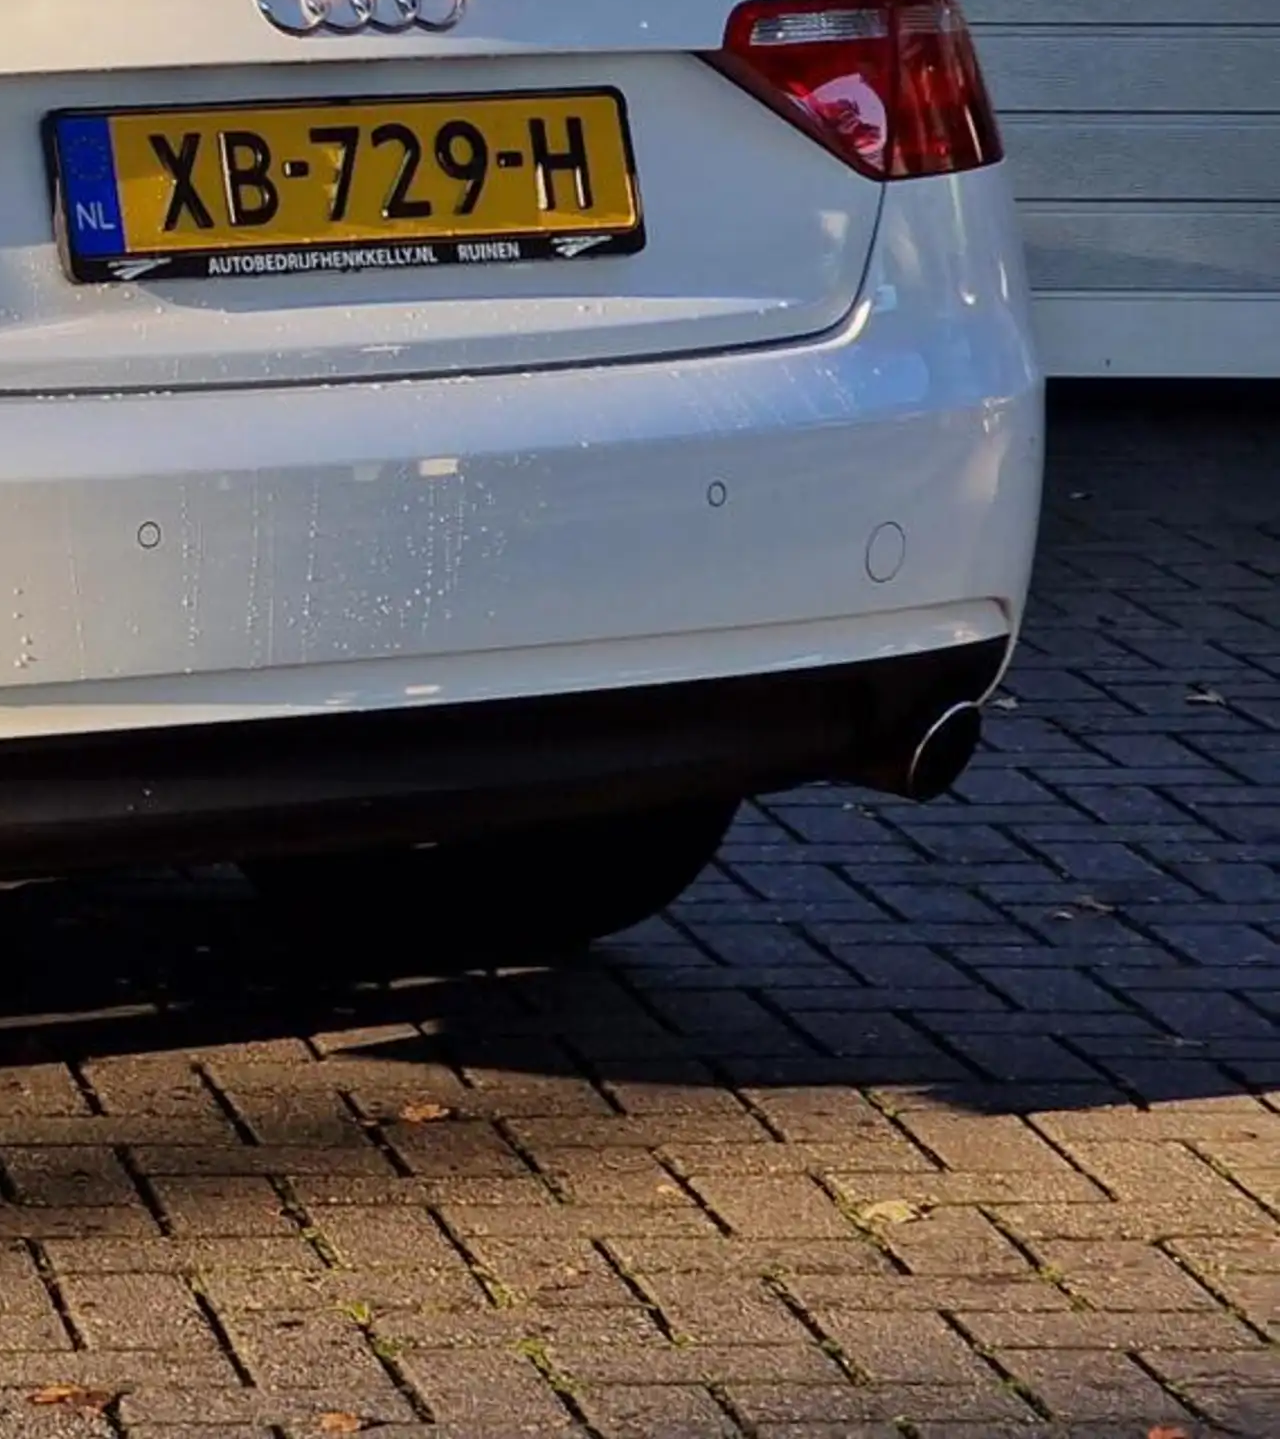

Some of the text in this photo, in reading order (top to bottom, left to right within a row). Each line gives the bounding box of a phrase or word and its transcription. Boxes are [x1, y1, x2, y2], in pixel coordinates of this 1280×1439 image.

[148, 116, 594, 233] XB-729-H
[75, 202, 116, 232] NL
[457, 241, 521, 262] RUINEN
